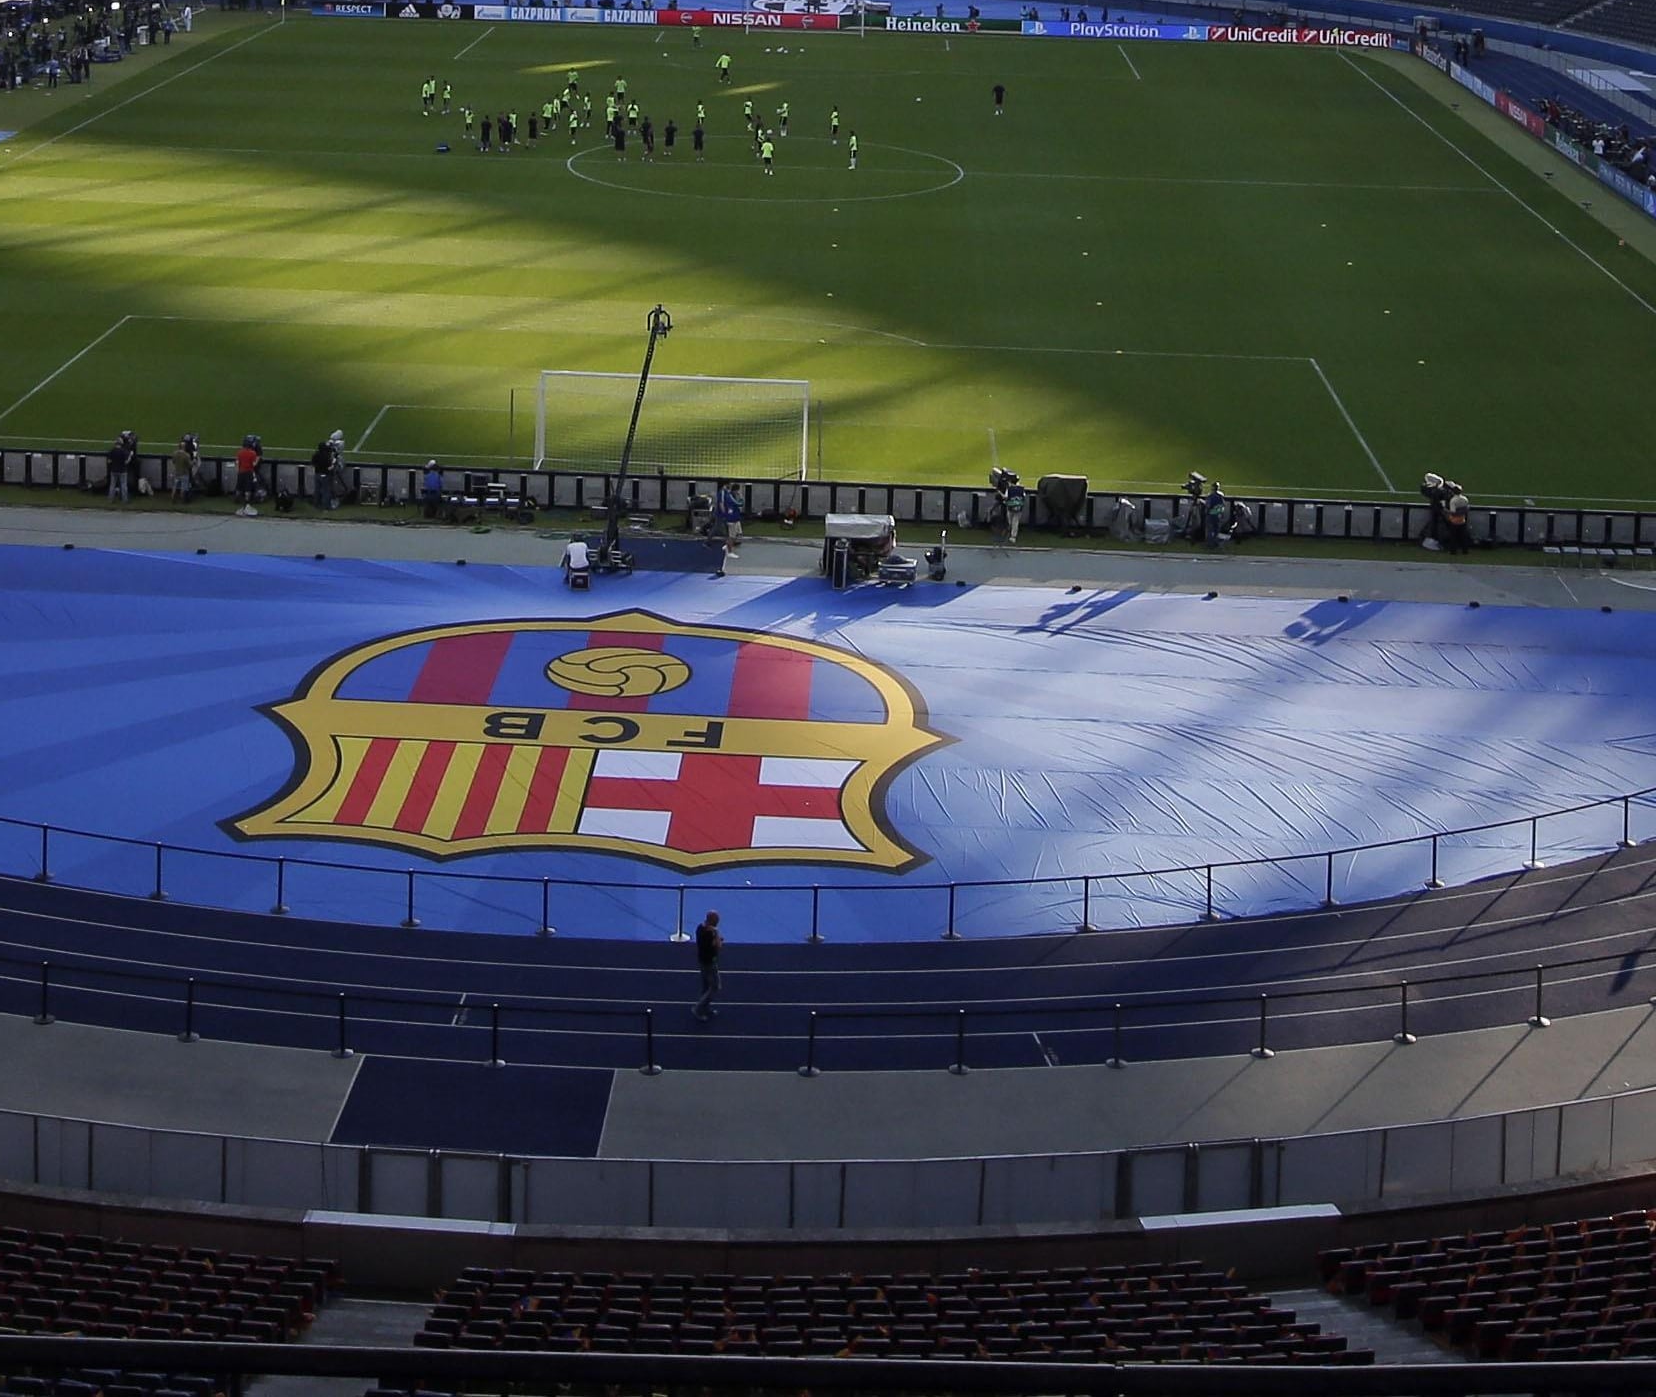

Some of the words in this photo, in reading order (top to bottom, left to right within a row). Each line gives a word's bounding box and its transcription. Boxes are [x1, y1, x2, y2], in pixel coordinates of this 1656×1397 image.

[336, 4, 372, 14] RESPECT
[511, 7, 561, 21] GAZPROM
[604, 10, 655, 24] GAZPROM
[713, 13, 781, 26] NISSAN
[885, 17, 960, 33] Heineken
[1071, 23, 1160, 38] PlayStation
[1228, 27, 1298, 43] UniCredit
[1319, 29, 1388, 47] UniCredit
[483, 711, 724, 749] FCB
